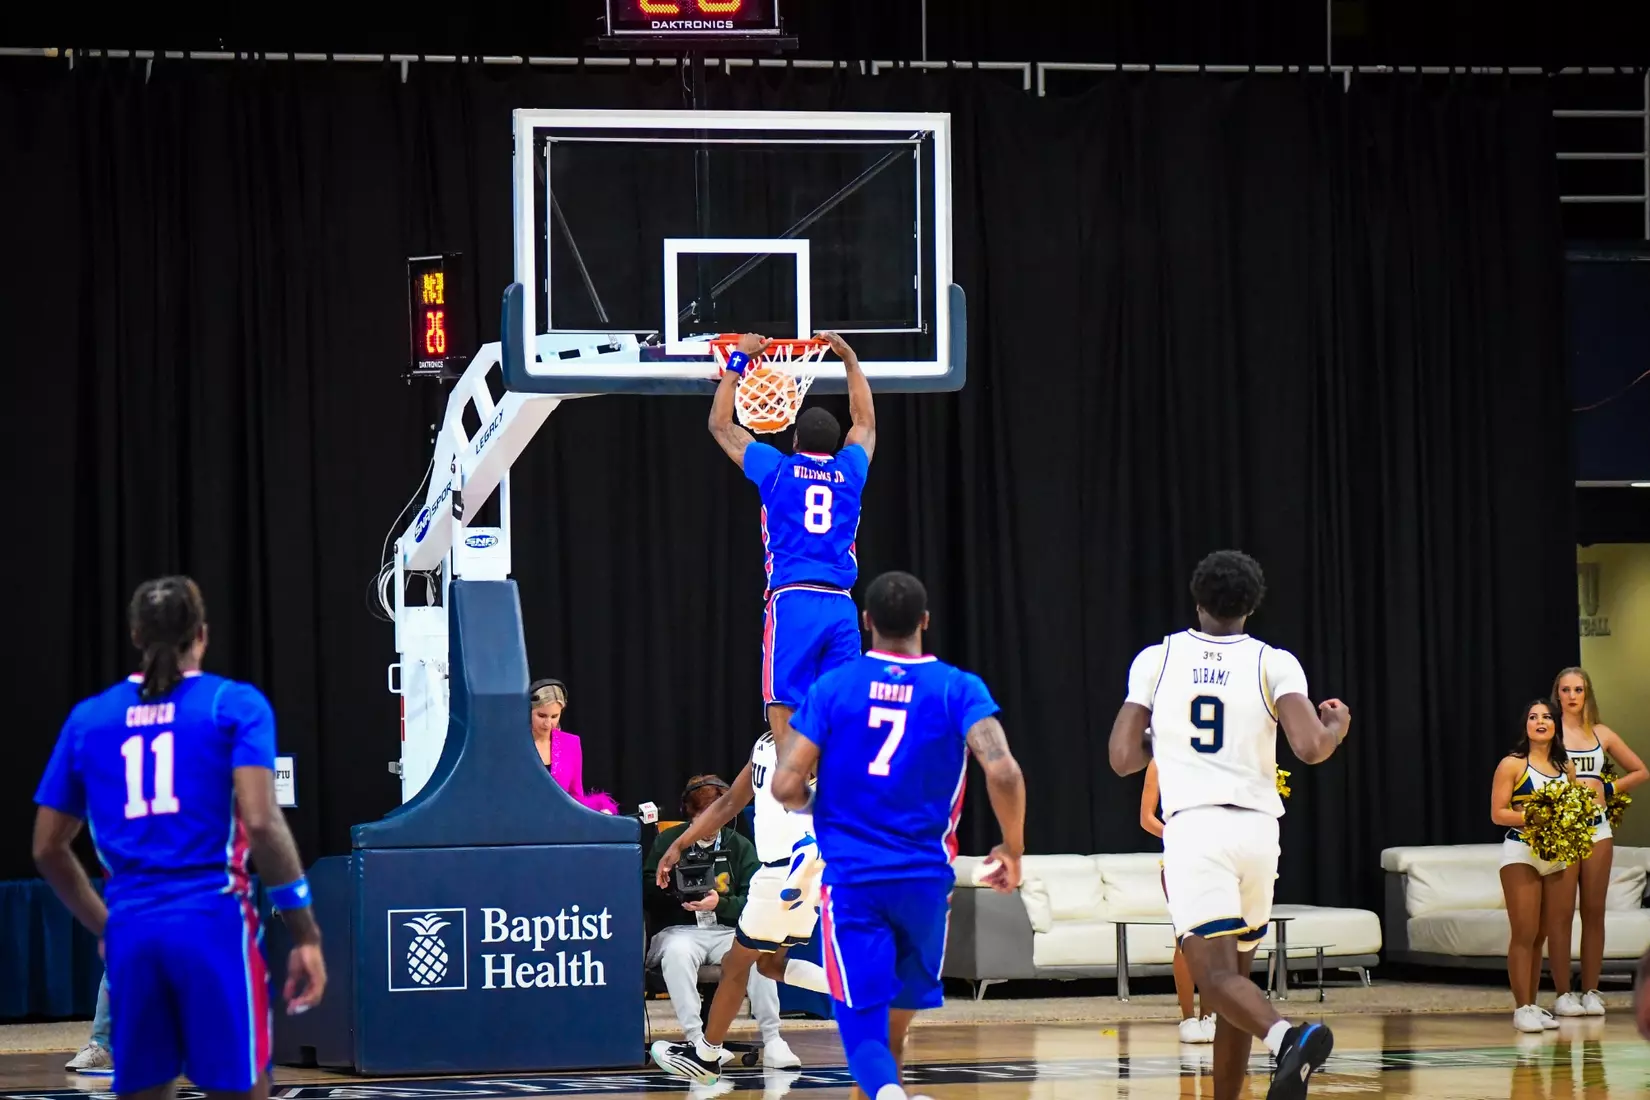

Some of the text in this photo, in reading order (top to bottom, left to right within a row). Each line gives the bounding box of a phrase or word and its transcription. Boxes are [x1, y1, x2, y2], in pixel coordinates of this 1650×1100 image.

[651, 20, 734, 29] DAKTRONICS
[419, 360, 444, 369] DAKTRONICS
[475, 408, 504, 455] LEGACY
[793, 465, 832, 482] WILLIAMS
[431, 480, 452, 516] SPOR
[804, 484, 833, 534] 8
[1193, 667, 1230, 686] DIBAMI
[126, 702, 176, 717] COOPER
[1189, 694, 1225, 754] 9
[868, 706, 907, 776] 7
[121, 731, 180, 819] 11
[276, 770, 291, 779] FIU
[1571, 757, 1595, 772] FIU
[480, 904, 613, 952] Baptist
[481, 950, 607, 989] Health
